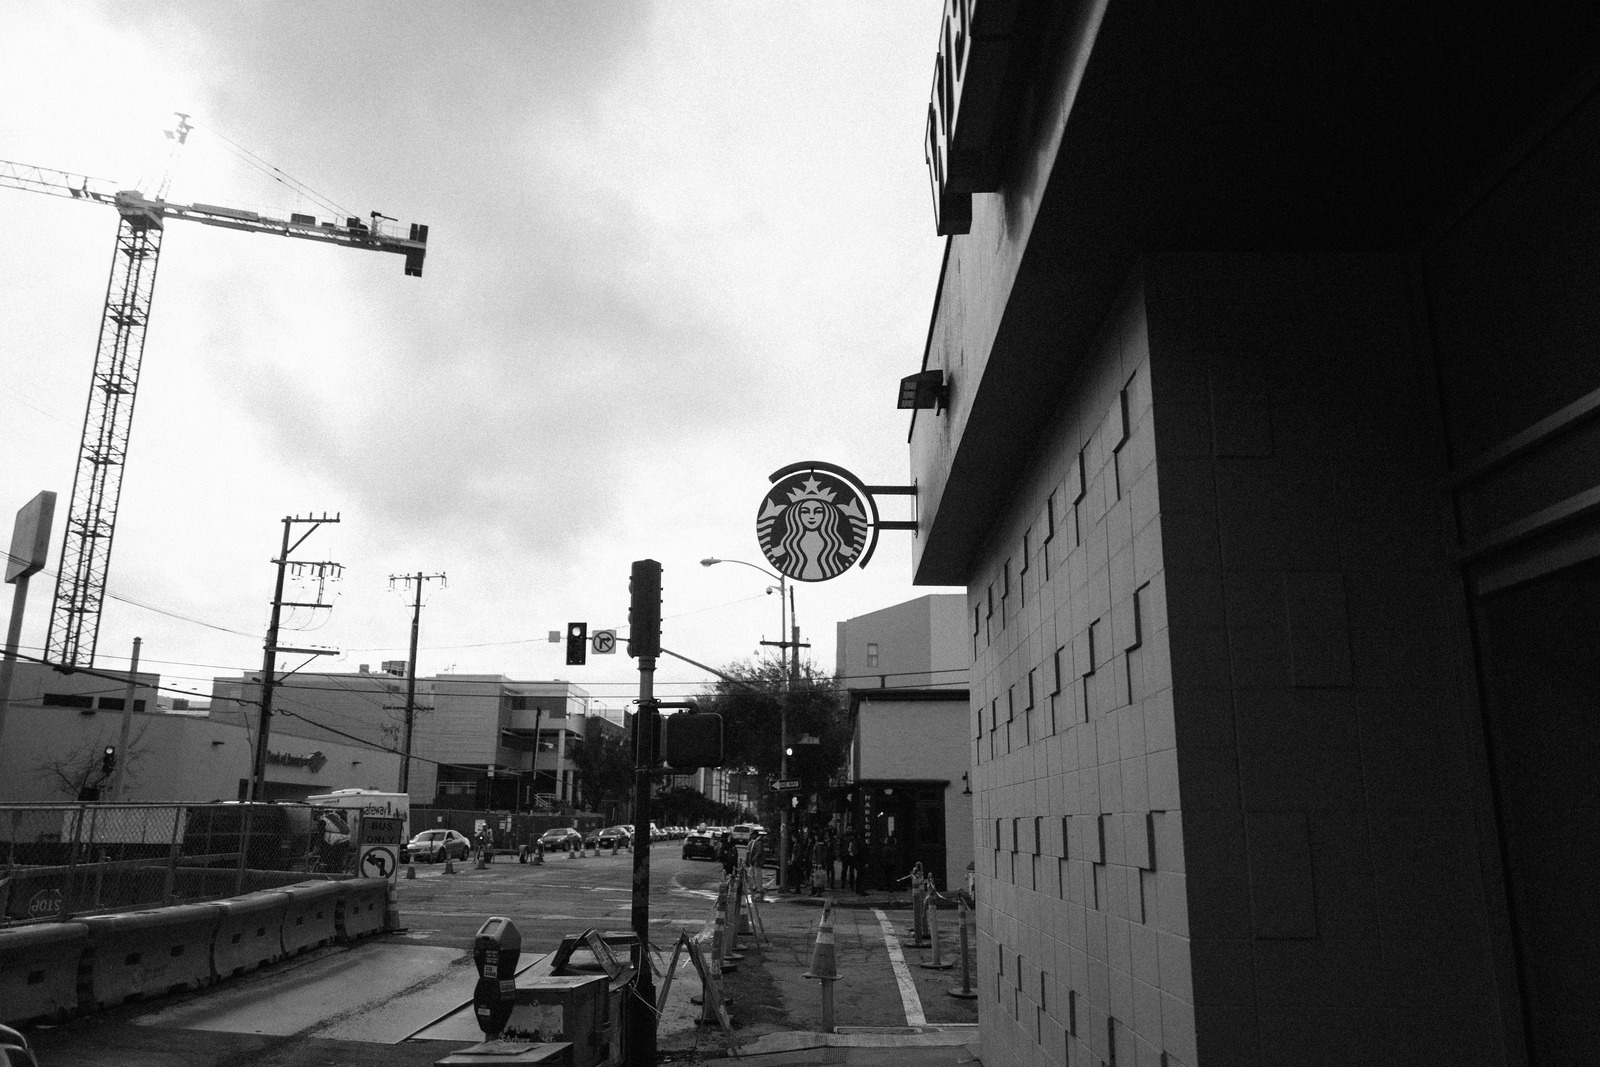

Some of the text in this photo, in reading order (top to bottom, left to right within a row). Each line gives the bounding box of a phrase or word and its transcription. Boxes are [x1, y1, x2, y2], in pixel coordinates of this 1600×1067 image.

[364, 801, 386, 817] afeway
[371, 821, 394, 831] BUS
[366, 835, 396, 844] ONLY
[32, 899, 62, 912] STOP
